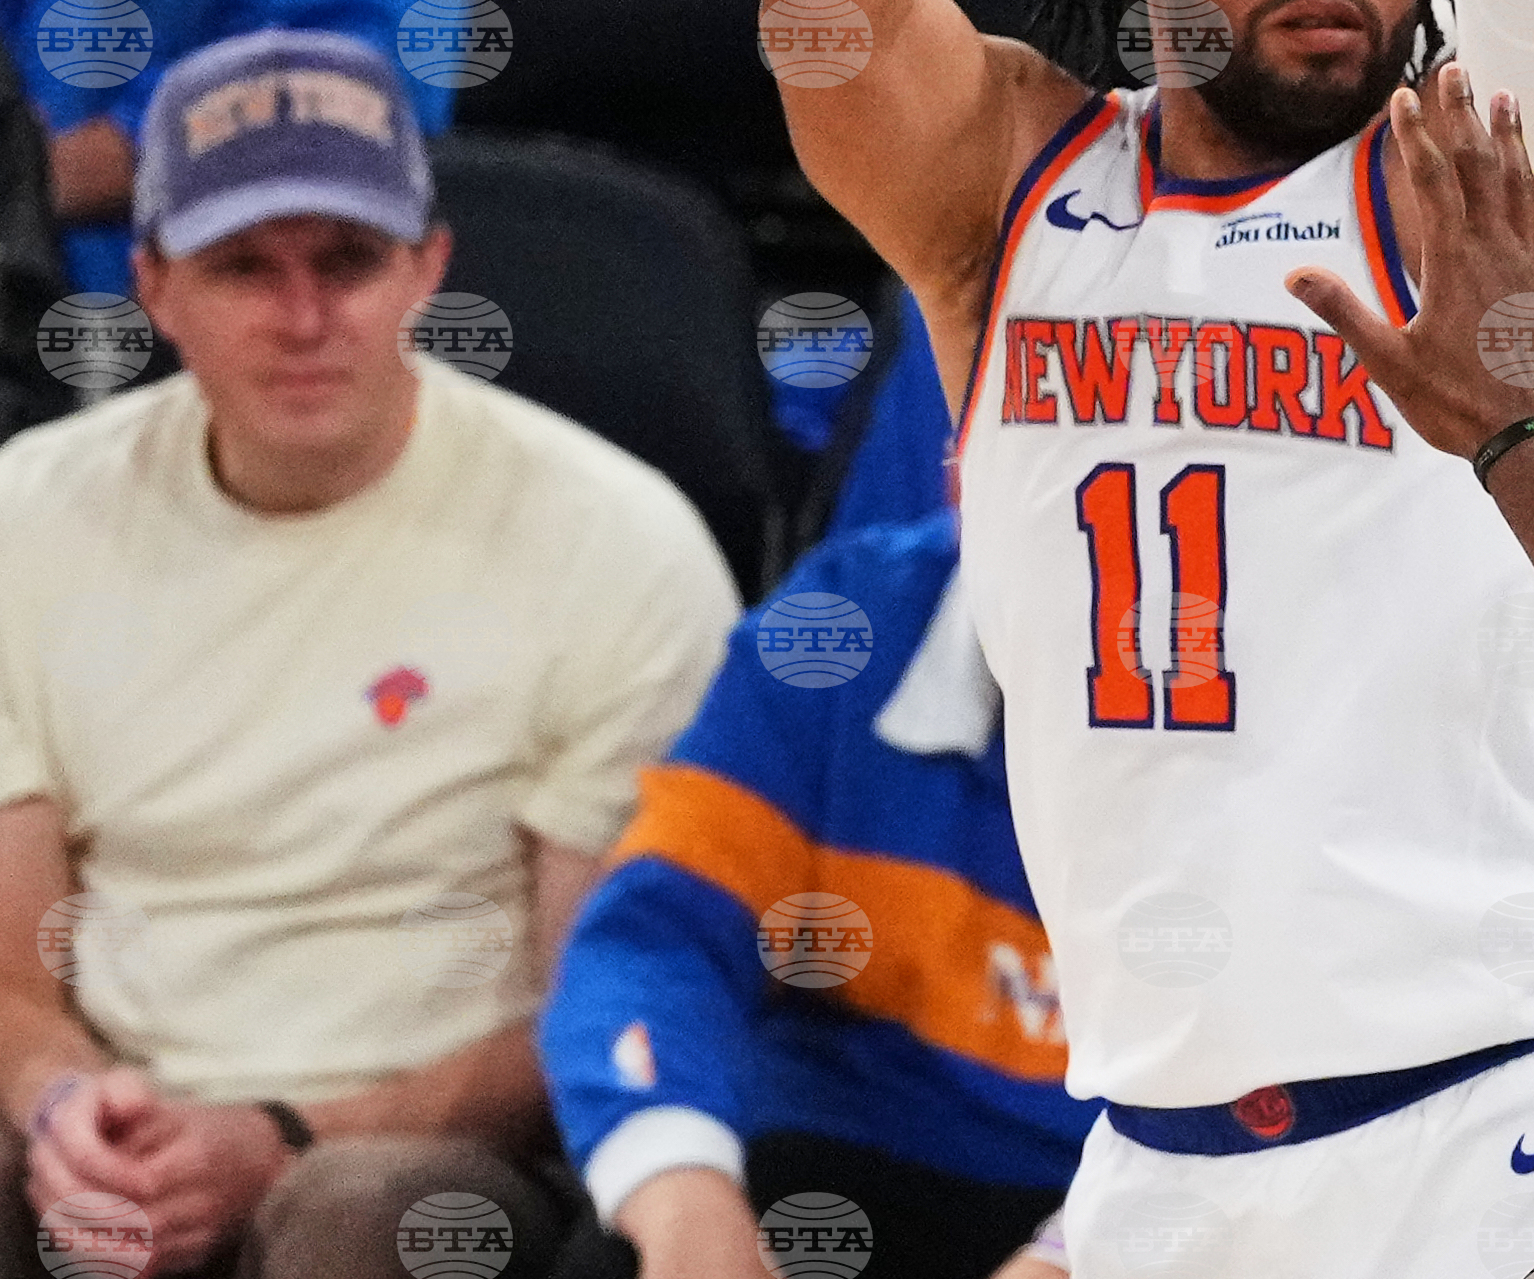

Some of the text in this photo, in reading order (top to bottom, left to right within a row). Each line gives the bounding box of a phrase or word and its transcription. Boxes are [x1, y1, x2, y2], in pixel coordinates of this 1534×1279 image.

[1215, 220, 1341, 249] abu dhabi
[1075, 462, 1237, 732] 11
